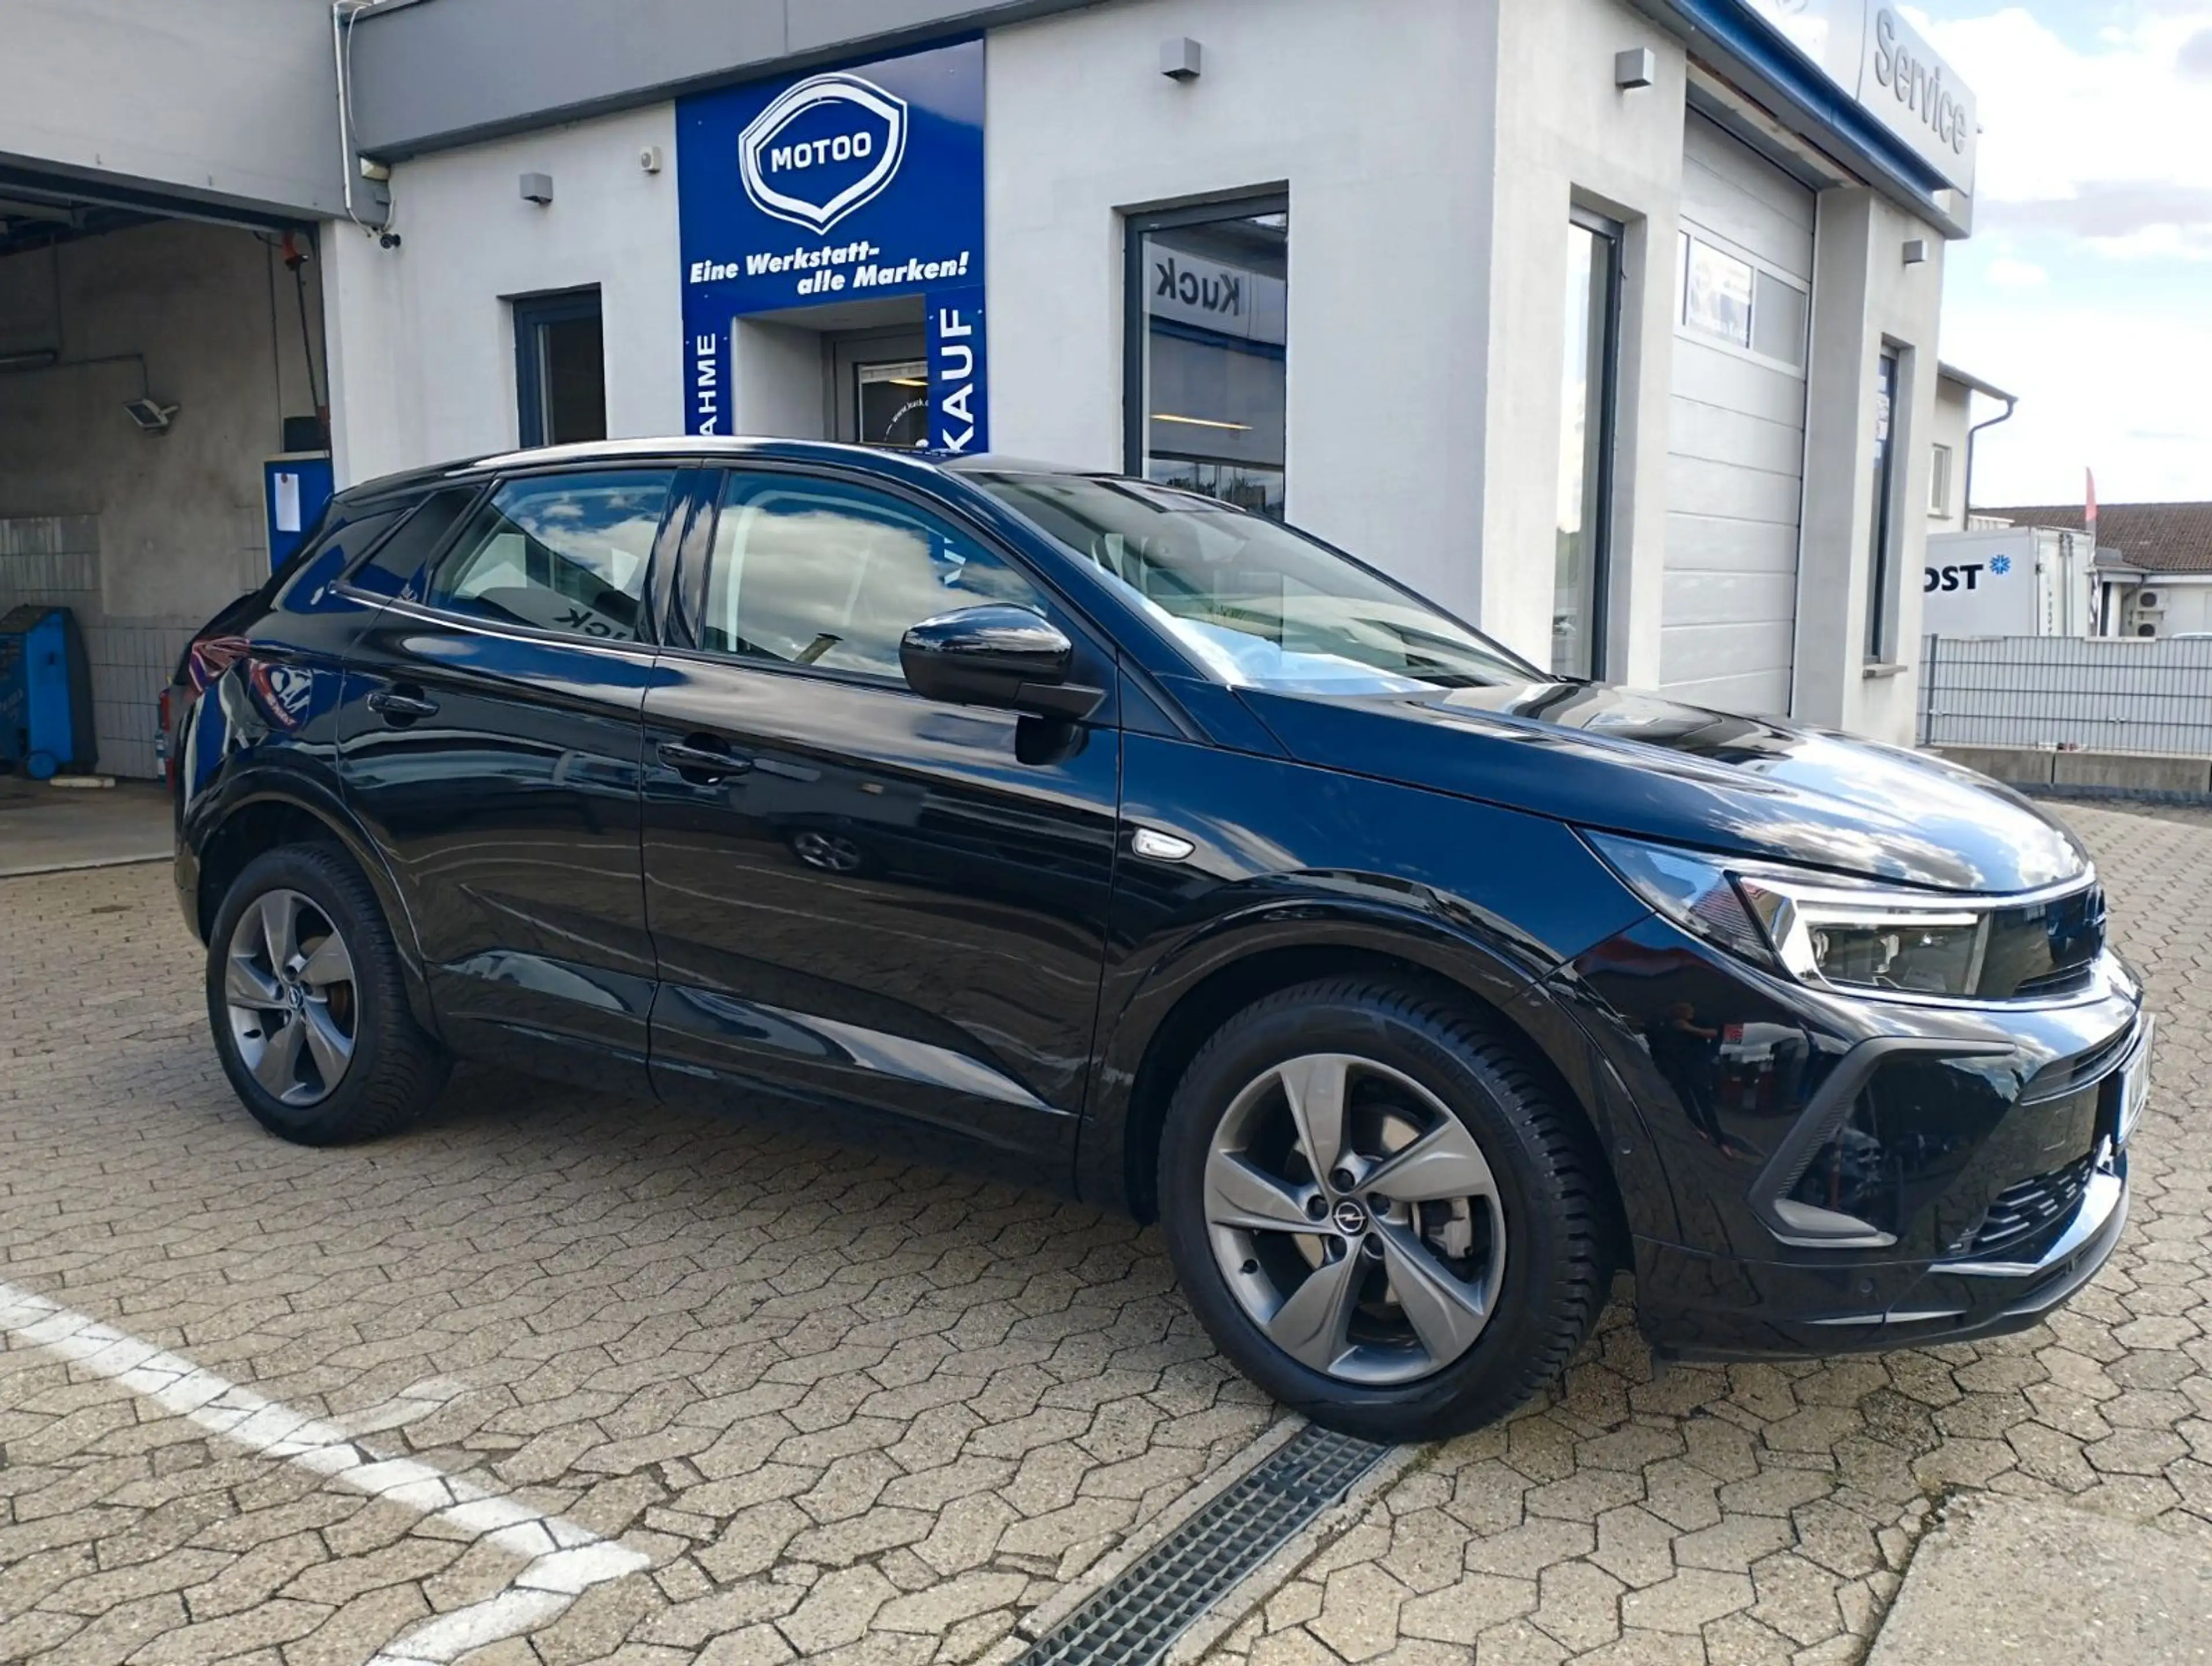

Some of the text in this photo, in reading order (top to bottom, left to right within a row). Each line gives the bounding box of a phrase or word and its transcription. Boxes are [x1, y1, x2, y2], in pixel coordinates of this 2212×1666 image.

[1874, 9, 1967, 155] Service
[771, 131, 872, 173] MOTOO
[690, 241, 880, 283] Eine Werkstatt-
[797, 250, 970, 295] alle Marken!
[696, 333, 717, 436] AHME
[940, 308, 974, 452] KAUF
